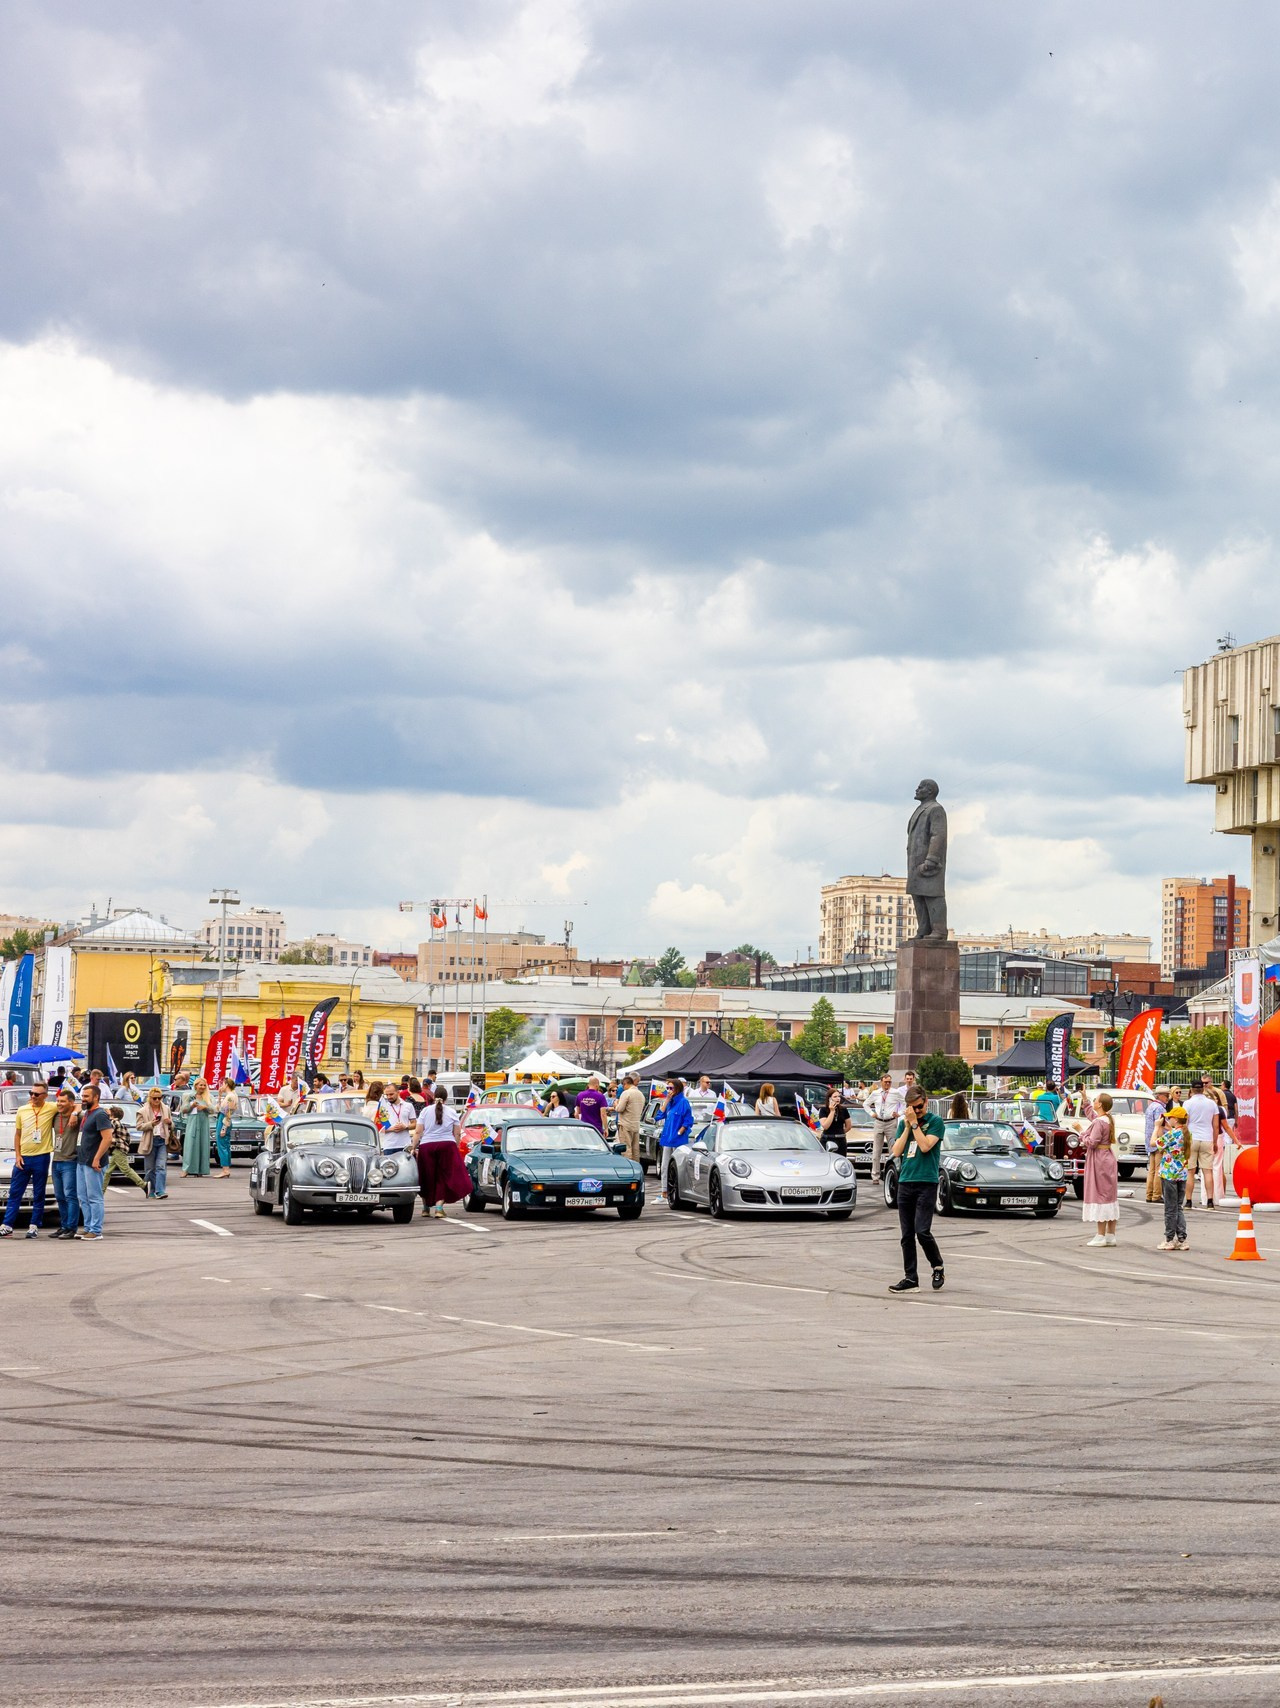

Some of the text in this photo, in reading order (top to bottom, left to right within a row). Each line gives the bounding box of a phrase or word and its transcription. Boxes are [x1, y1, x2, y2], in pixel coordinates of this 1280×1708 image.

[214, 1040, 224, 1062] Банк
[267, 1032, 282, 1089] Альфа Банк
